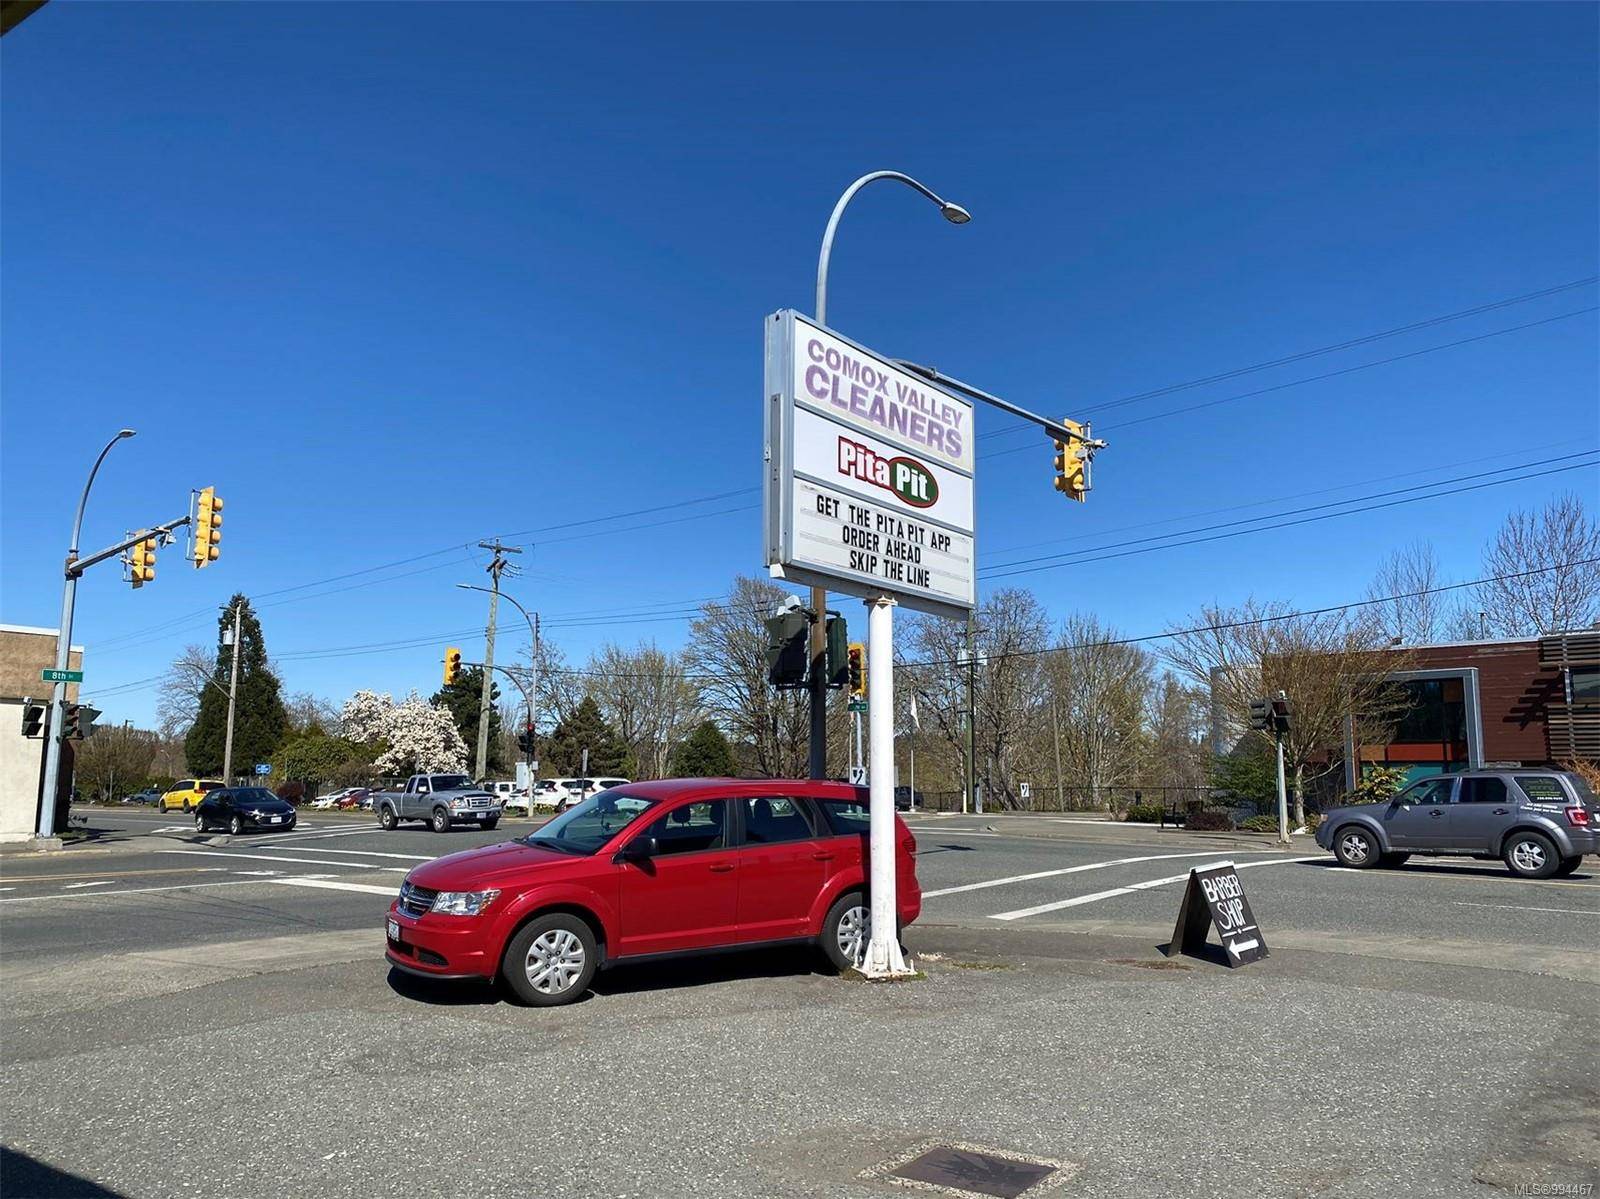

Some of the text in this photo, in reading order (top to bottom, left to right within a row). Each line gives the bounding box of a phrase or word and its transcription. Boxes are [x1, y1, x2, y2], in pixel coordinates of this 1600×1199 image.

[807, 338, 963, 428] COMOX VALLEY
[805, 364, 963, 459] CLEANERS
[838, 435, 928, 501] Pita Pit
[816, 494, 951, 552] GET THE PITA PIT APP
[842, 525, 922, 564] ORDER AHEAD
[850, 550, 930, 588] SKIP THE LINE
[52, 671, 66, 680] 8th
[1201, 874, 1244, 903] BARBER
[1217, 898, 1246, 930] SHOP
